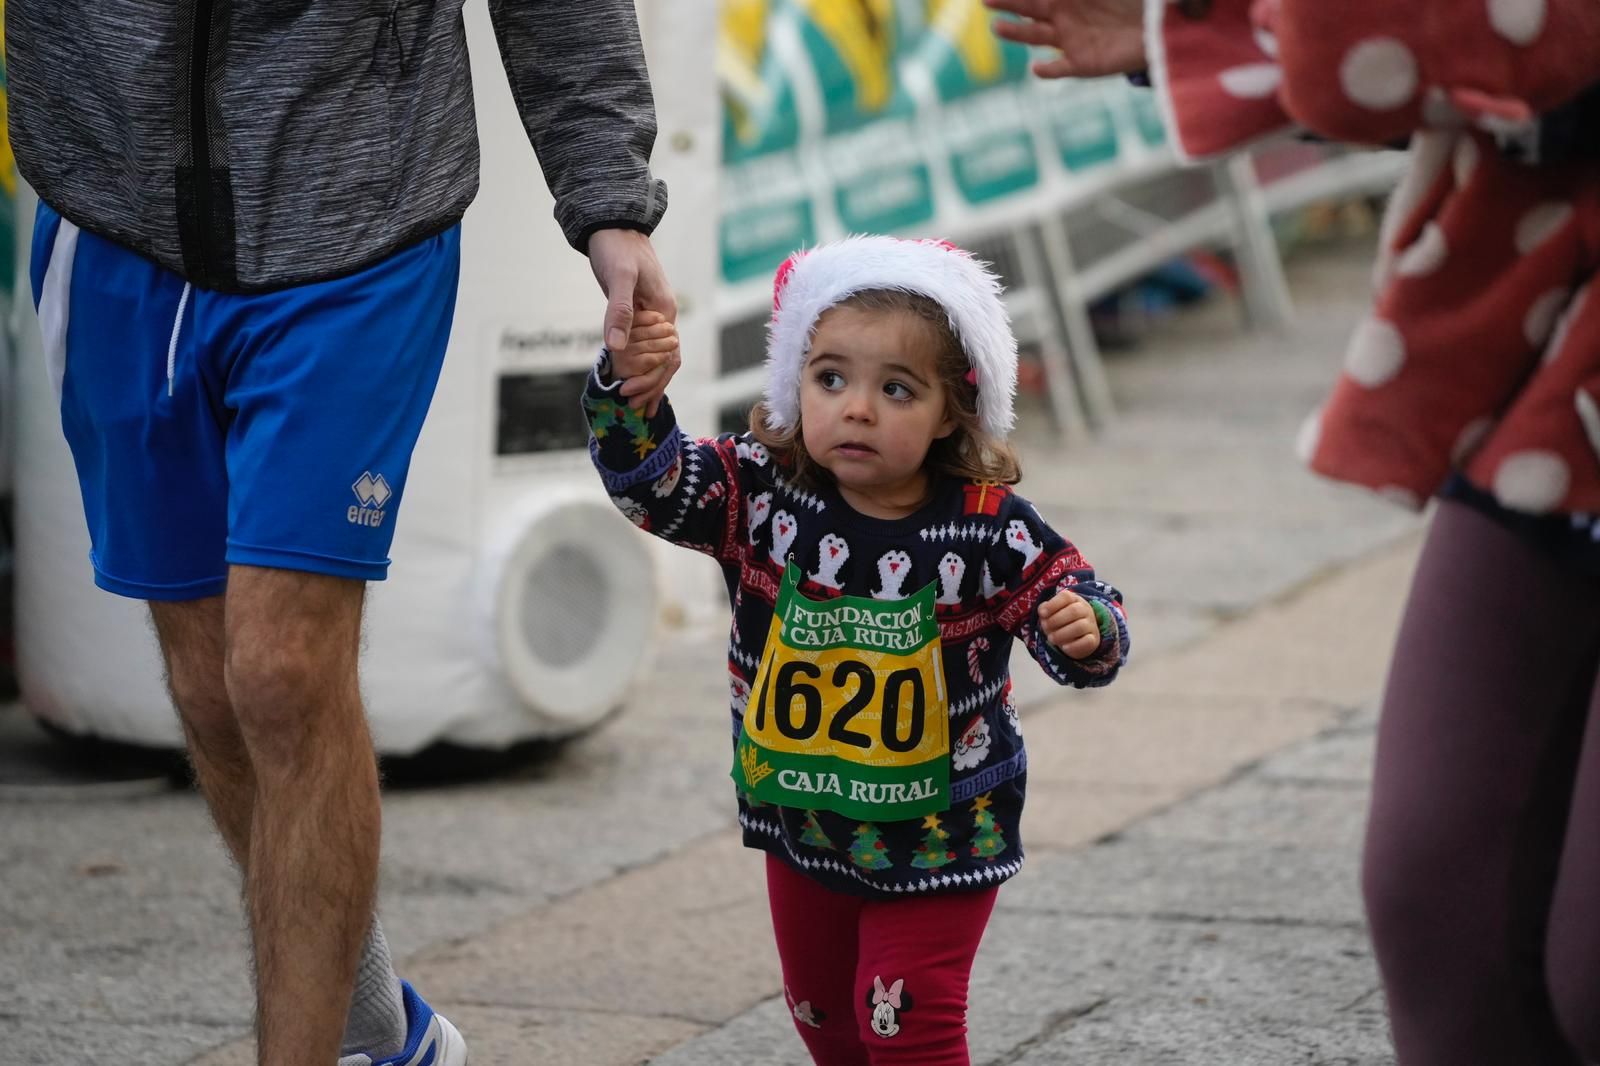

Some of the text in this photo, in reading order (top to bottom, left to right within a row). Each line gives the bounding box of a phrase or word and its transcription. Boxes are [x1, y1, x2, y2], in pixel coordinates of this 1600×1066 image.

[792, 602, 922, 631] FUNDACION
[791, 626, 923, 650] CAJA RURAL
[778, 769, 939, 803] CAJA RURAL
